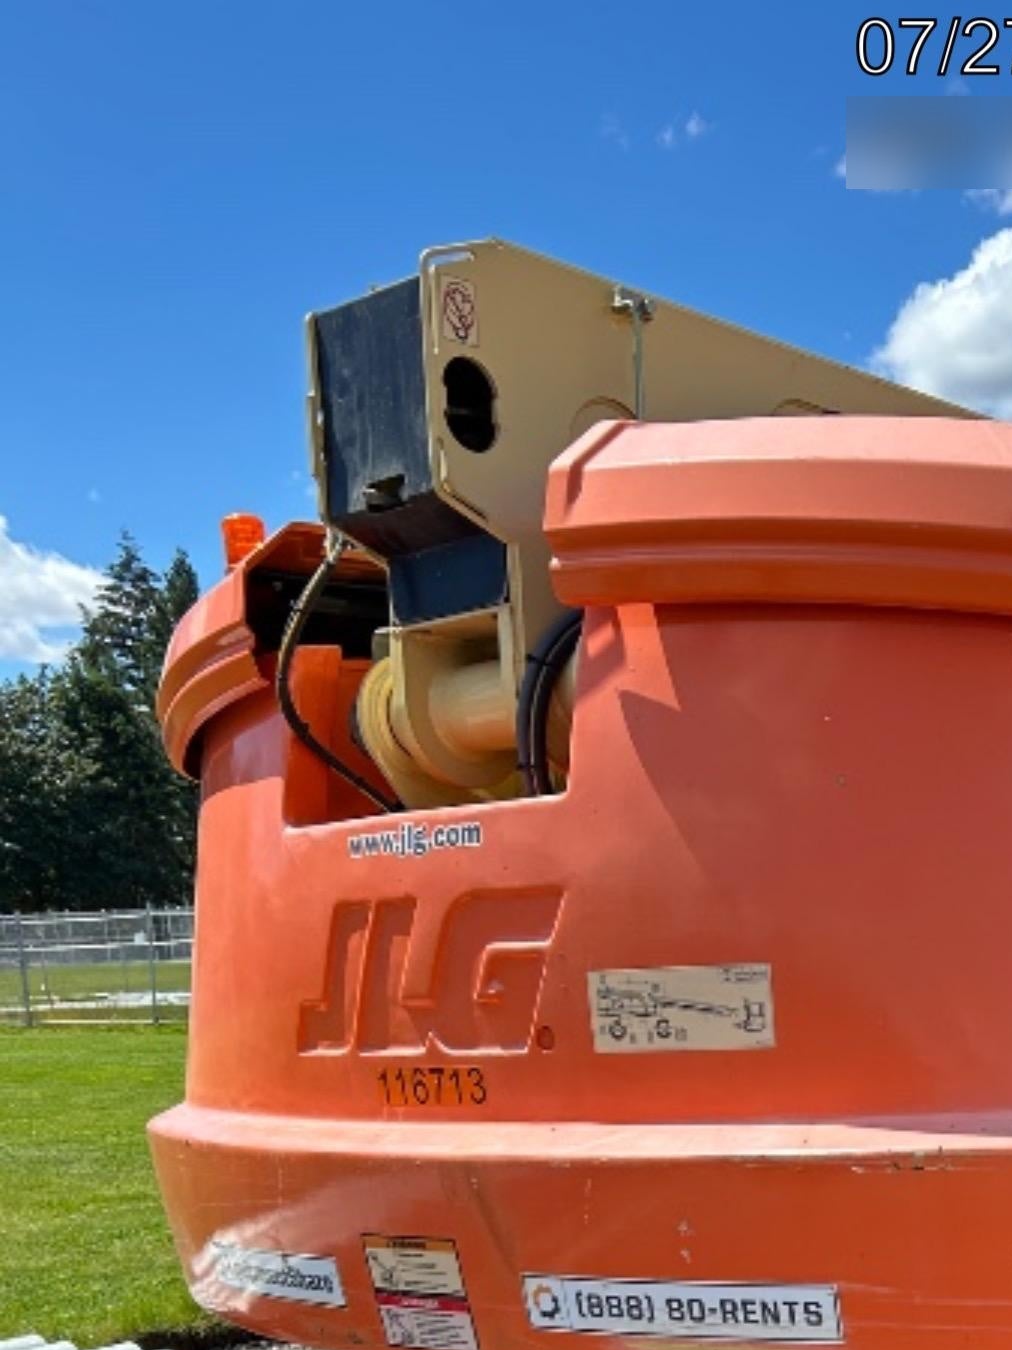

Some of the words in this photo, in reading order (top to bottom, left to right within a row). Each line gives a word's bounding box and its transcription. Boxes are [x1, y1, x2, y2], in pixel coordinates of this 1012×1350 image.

[349, 823, 481, 856] www.jlg.com
[297, 885, 566, 1056] JLG
[377, 1067, 488, 1105] 116713
[575, 1289, 655, 1323] (888)
